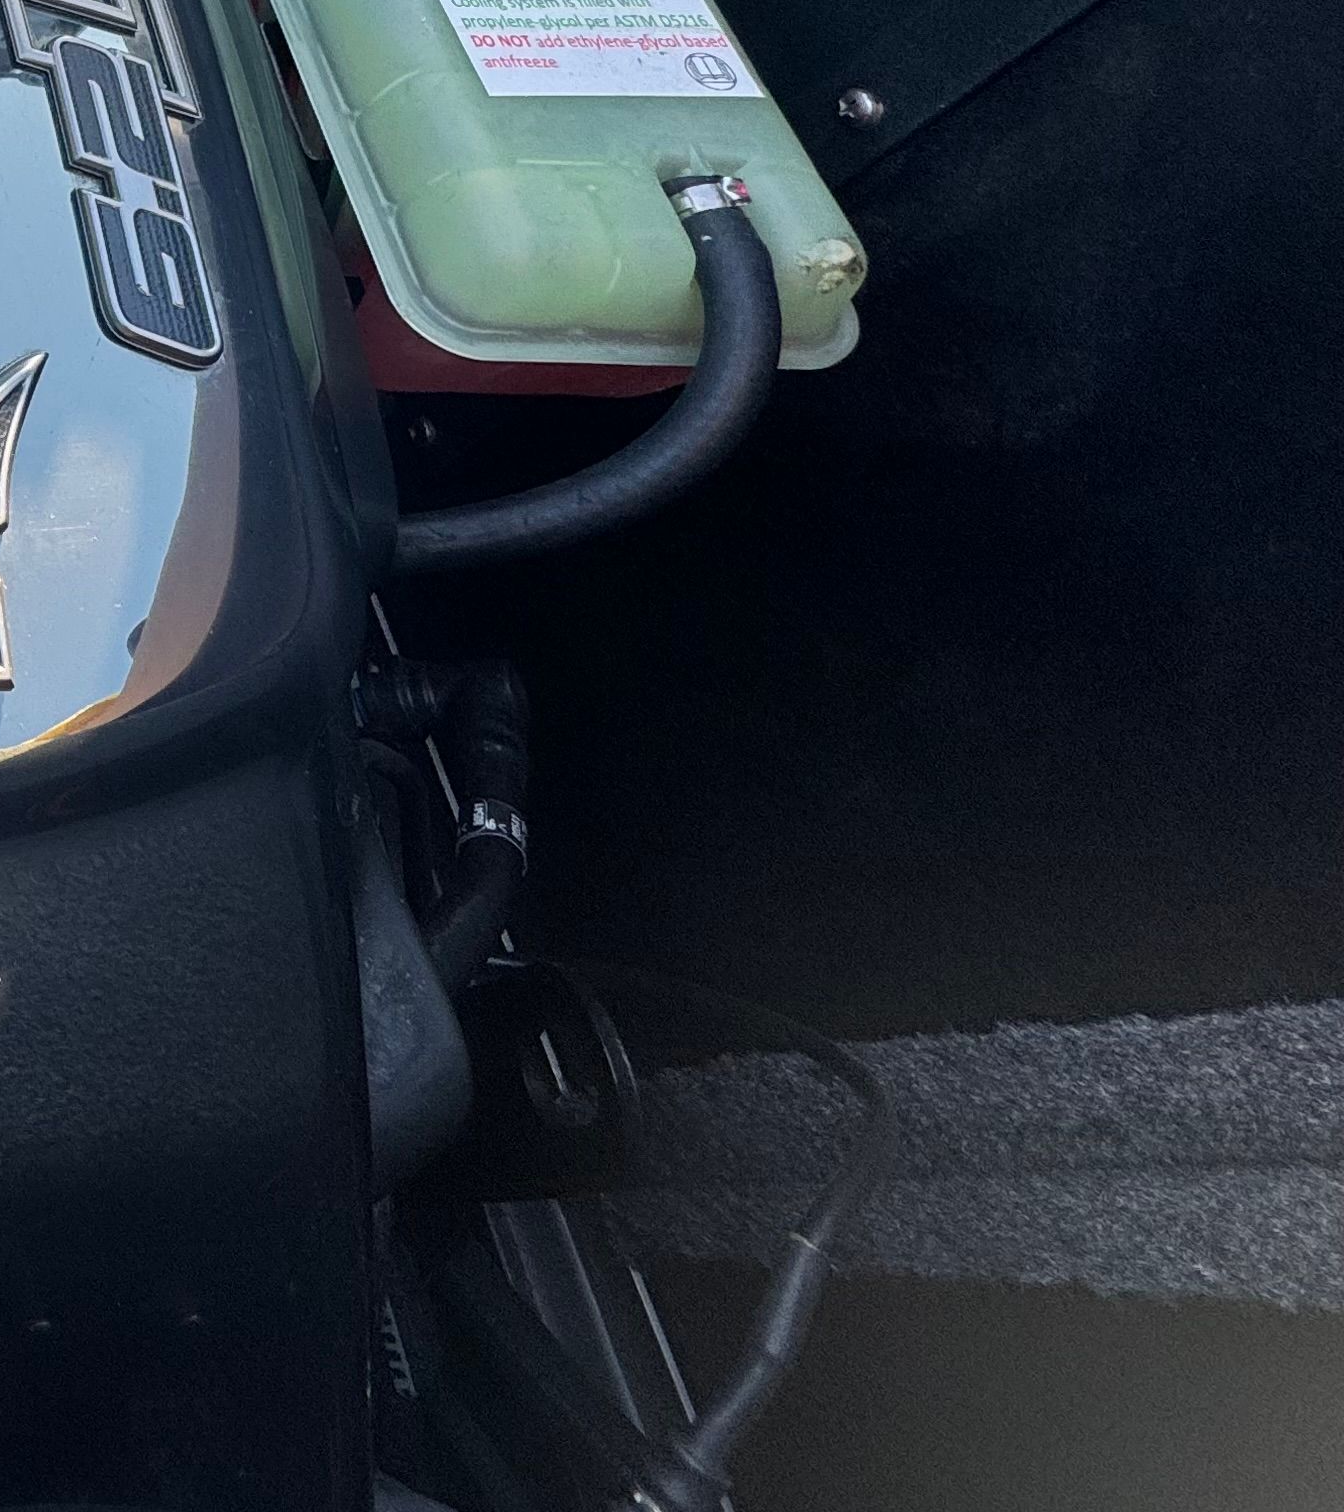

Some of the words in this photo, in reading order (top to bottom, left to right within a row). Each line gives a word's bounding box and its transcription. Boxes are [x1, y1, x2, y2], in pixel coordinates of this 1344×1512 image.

[461, 14, 582, 31] propylene-glycol
[585, 17, 610, 31] per
[614, 15, 658, 28] ASTM
[471, 35, 496, 48] DO
[497, 34, 532, 48] NOT
[536, 34, 564, 48] add
[567, 34, 681, 51] ethylene-glycol
[682, 34, 729, 48] based
[483, 55, 558, 68] antifreeze
